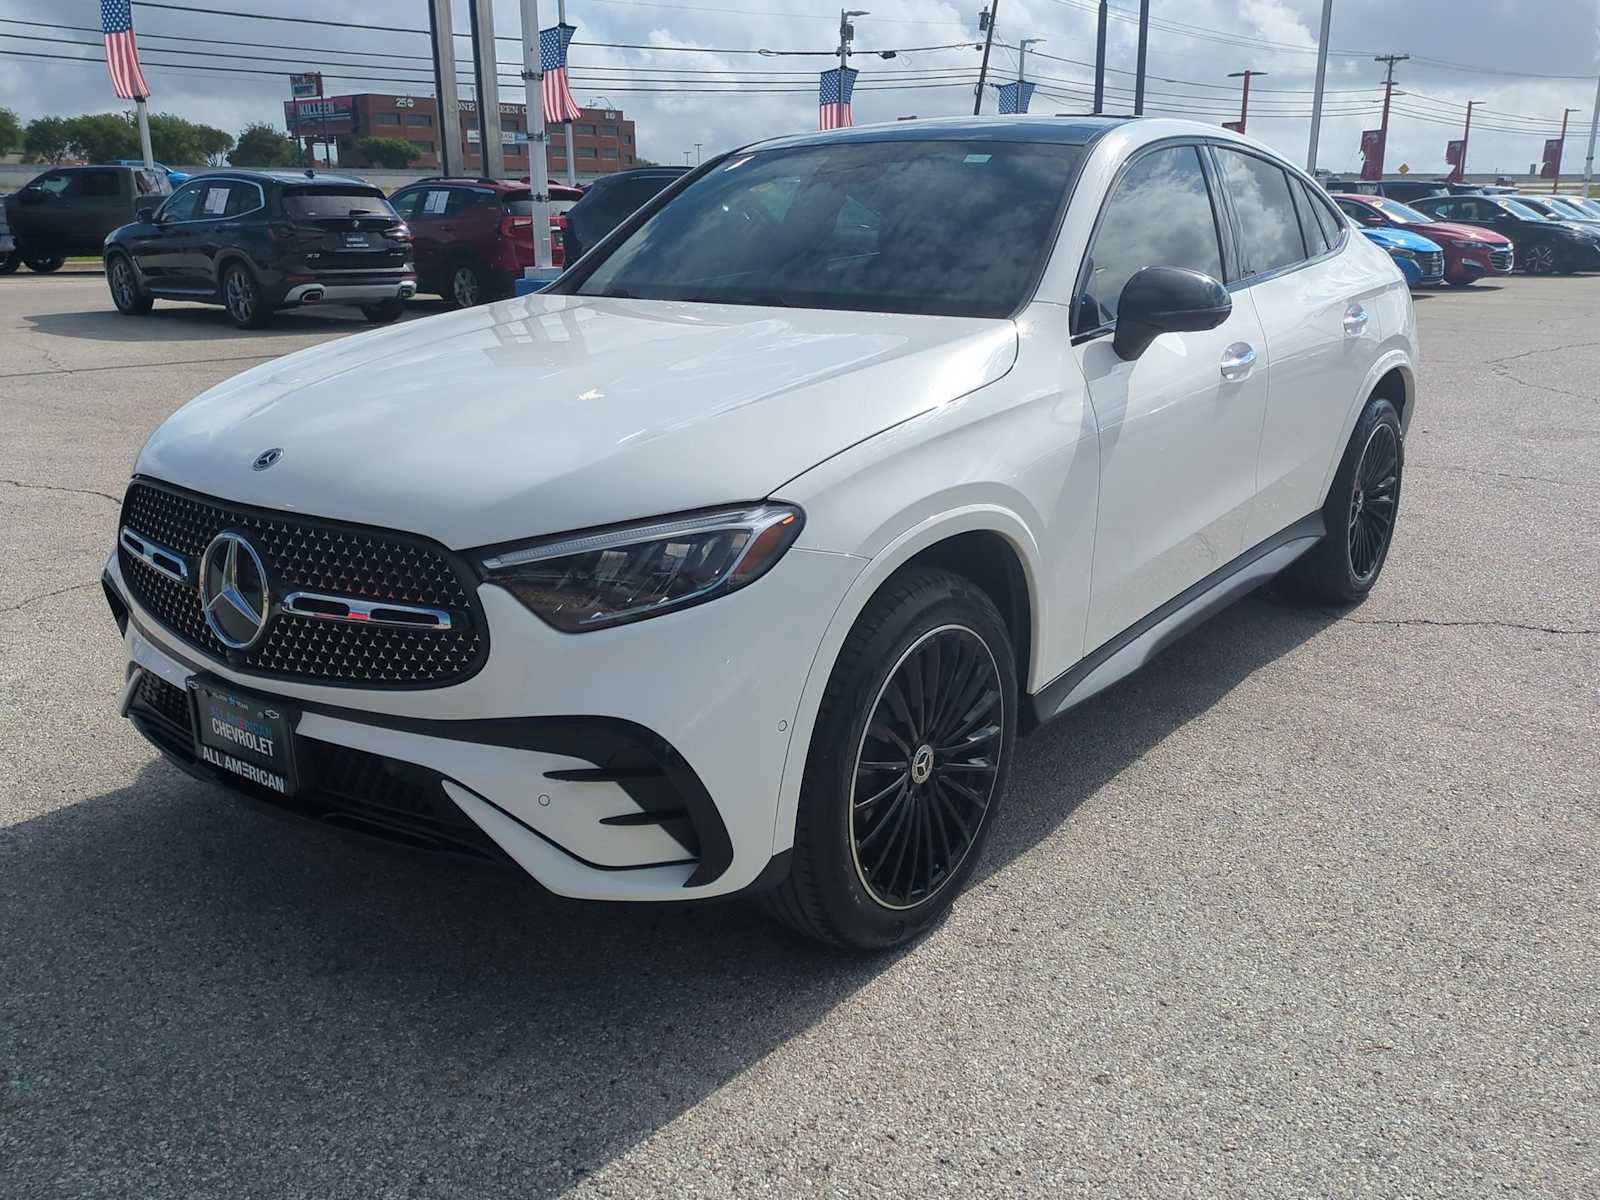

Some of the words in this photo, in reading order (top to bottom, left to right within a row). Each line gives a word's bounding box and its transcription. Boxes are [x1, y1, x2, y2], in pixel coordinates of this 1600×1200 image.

[298, 101, 335, 116] KILLEEN
[211, 717, 274, 757] CHEVROLET
[203, 746, 224, 768] ALL
[224, 756, 285, 793] AMERICAN
